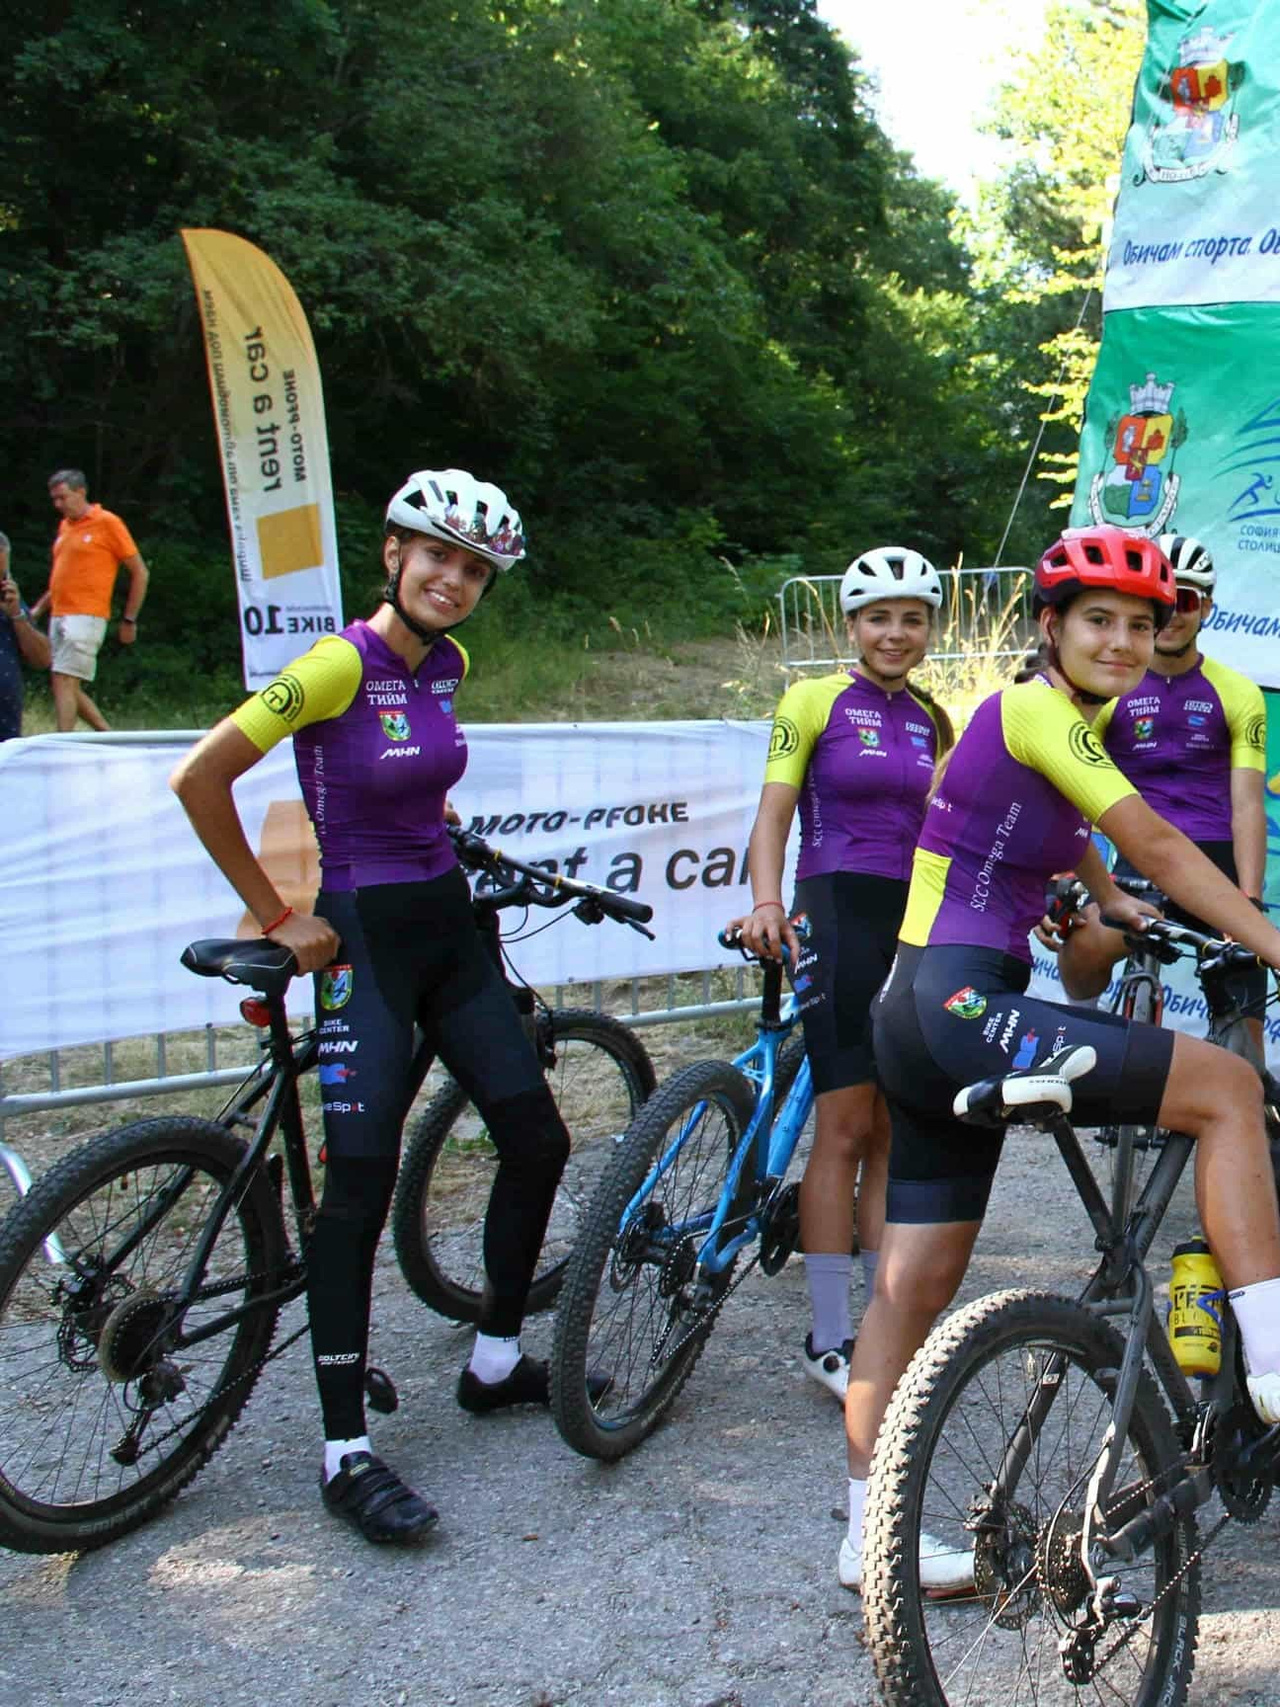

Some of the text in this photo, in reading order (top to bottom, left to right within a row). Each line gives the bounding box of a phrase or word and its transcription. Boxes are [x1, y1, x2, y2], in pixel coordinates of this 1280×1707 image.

[1123, 239, 1183, 266] Обичам
[1240, 524, 1279, 538] СОФИЯ
[366, 679, 406, 692] ОМЕГА
[367, 692, 408, 706] ТИЙМ
[1127, 696, 1161, 708] ОМЕГА
[977, 840, 1004, 885] Omega
[996, 802, 1022, 838] Team
[606, 851, 643, 893] a
[1172, 1614, 1187, 1674] BLACK
[1163, 1674, 1179, 1707] JAC
